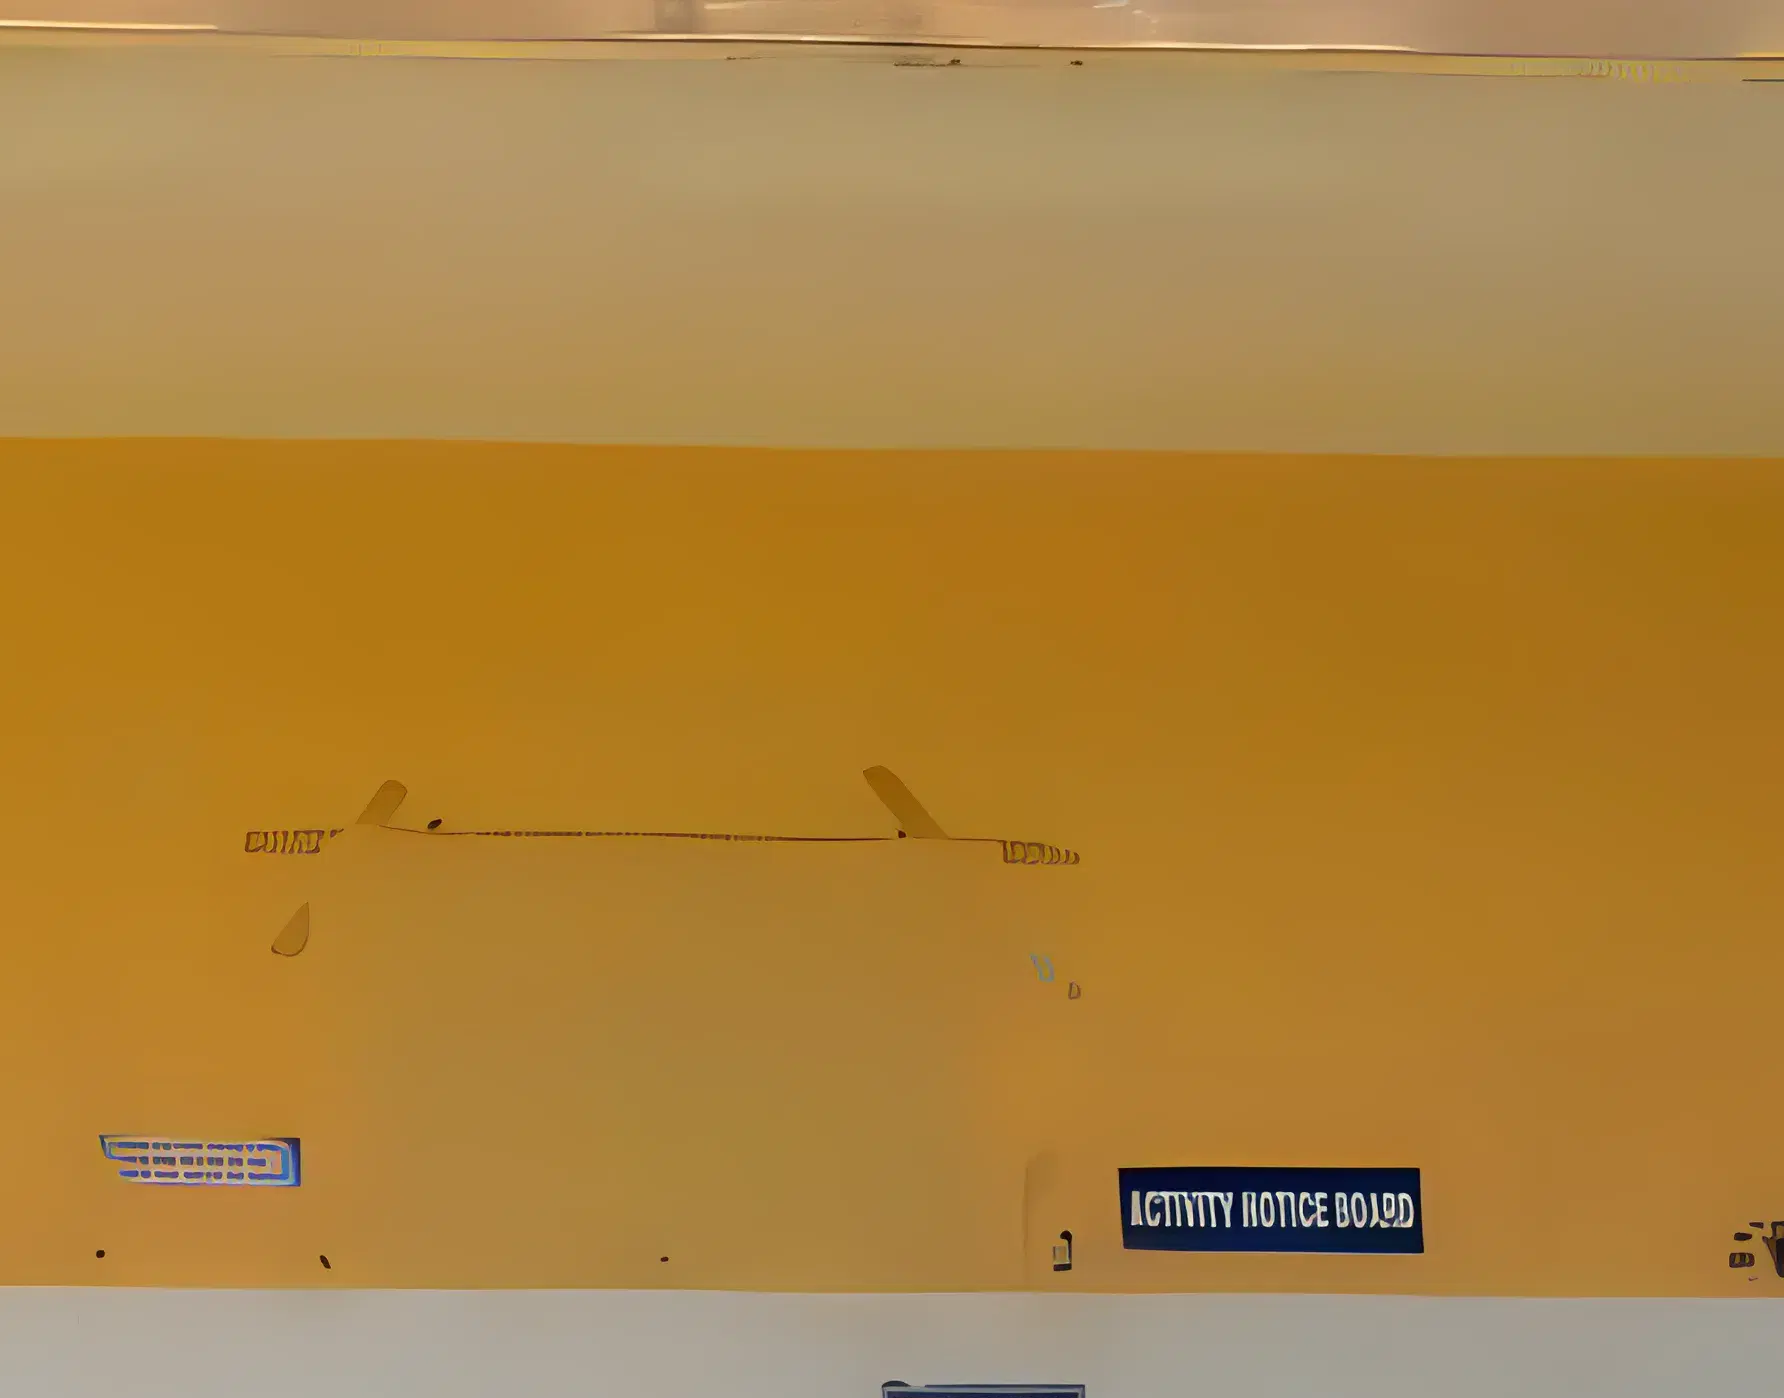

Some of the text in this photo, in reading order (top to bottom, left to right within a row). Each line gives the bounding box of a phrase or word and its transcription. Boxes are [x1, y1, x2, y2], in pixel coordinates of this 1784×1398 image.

[1131, 1190, 1415, 1228] ACTIVITY NOTICE BOARD
